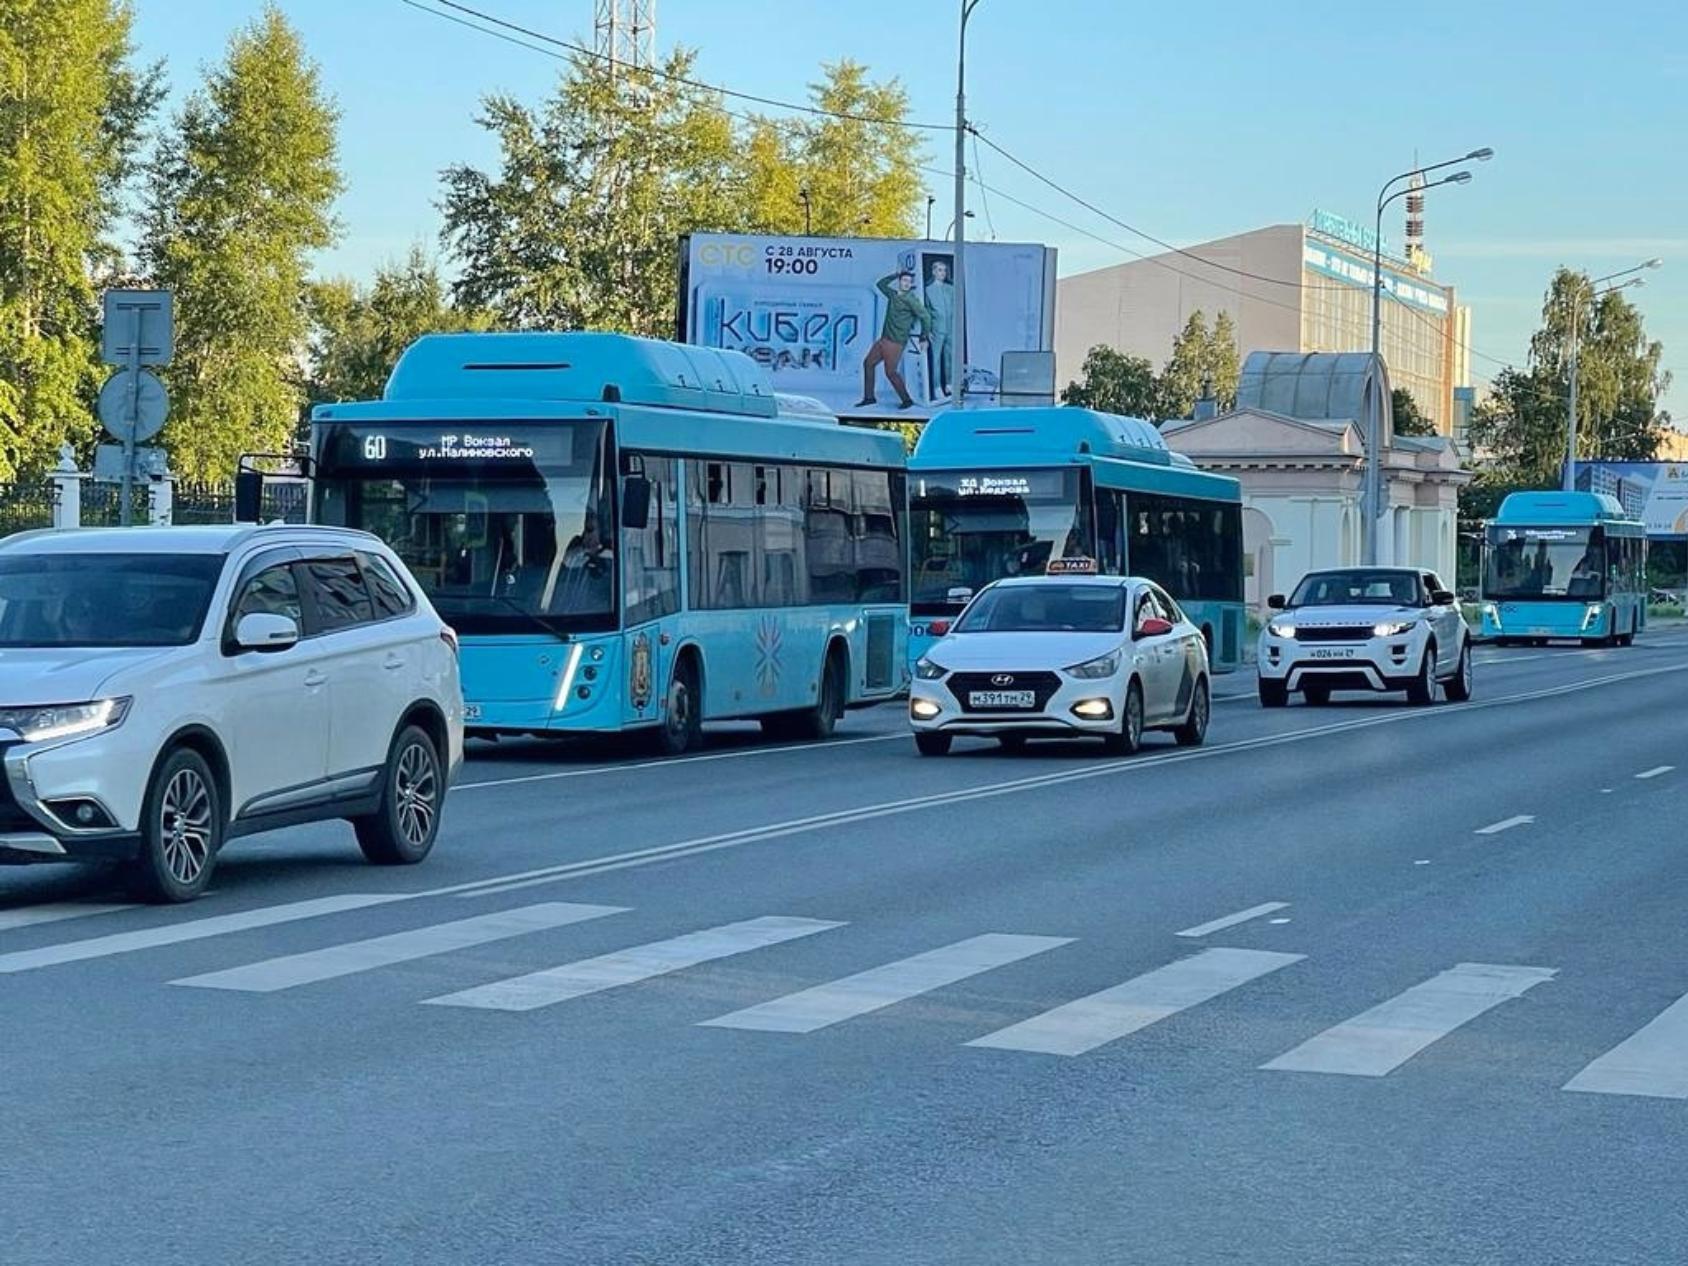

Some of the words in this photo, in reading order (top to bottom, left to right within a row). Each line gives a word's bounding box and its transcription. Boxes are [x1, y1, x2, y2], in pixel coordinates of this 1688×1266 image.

[765, 245, 775, 256] С
[778, 246, 793, 257] 28
[797, 246, 853, 258] АВГУСТА
[764, 258, 818, 275] 19:00
[364, 435, 387, 459] 60
[463, 435, 511, 447] Вокзал
[1066, 561, 1090, 570] TAXI
